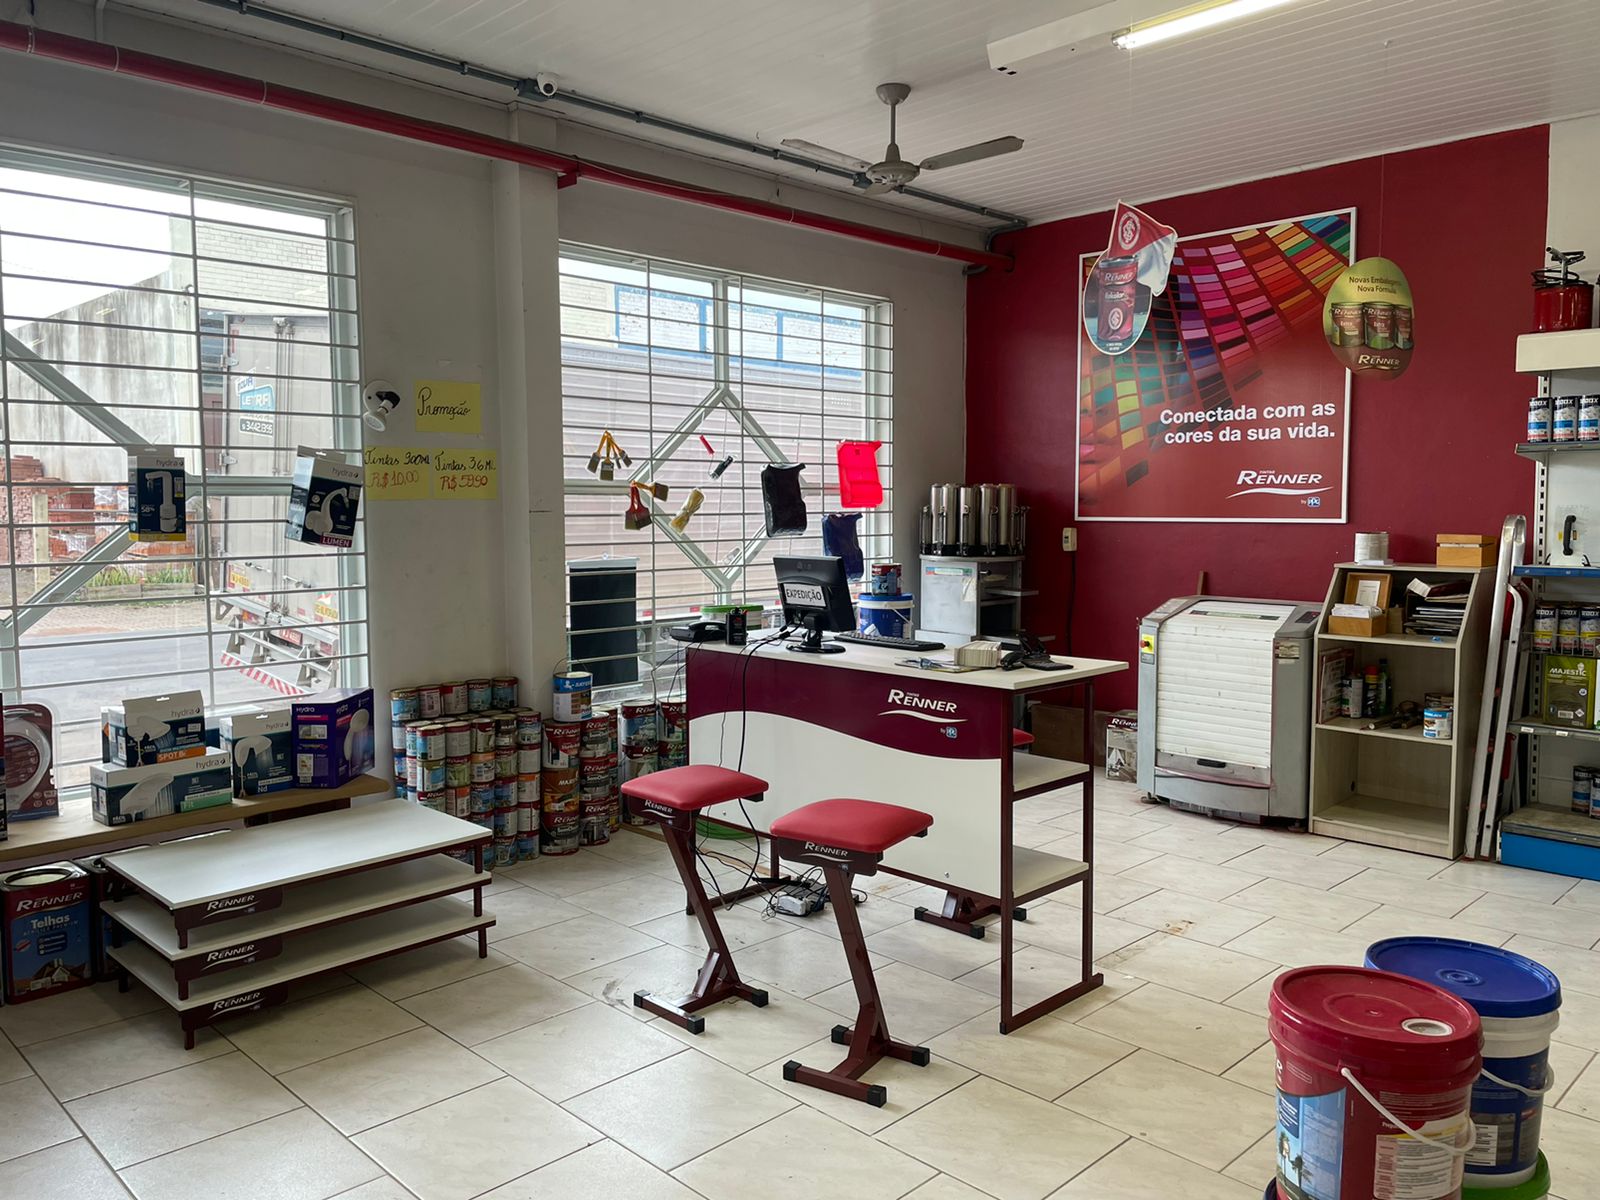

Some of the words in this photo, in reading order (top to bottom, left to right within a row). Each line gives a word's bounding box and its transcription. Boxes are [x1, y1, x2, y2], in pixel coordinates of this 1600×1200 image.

[1349, 276, 1369, 284] Novas
[1358, 354, 1400, 365] RENNER
[417, 386, 471, 420] Promoção
[1160, 405, 1257, 425] Conectada
[1263, 403, 1305, 419] com
[1312, 402, 1336, 416] as
[1164, 430, 1214, 444] cores
[1218, 426, 1241, 442] da
[1247, 427, 1282, 441] sua
[1287, 422, 1335, 439] vida.
[364, 447, 400, 466] Tintas
[435, 451, 467, 472] Tintas
[1236, 470, 1323, 485] RENNER
[322, 537, 350, 547] LUMEN
[785, 588, 822, 602] EXPEDIÇÃO
[1549, 667, 1588, 676] MAJESTIC
[887, 688, 958, 713] RENNER
[158, 751, 177, 761] SPOT
[196, 759, 221, 770] hydra
[644, 799, 673, 814] RENNER
[804, 841, 848, 857] RENNER
[16, 892, 83, 912] RENNER
[206, 895, 255, 911] RENNER
[31, 914, 71, 929] Telhas
[206, 944, 255, 962] RENNER
[213, 992, 261, 1011] RENNER
